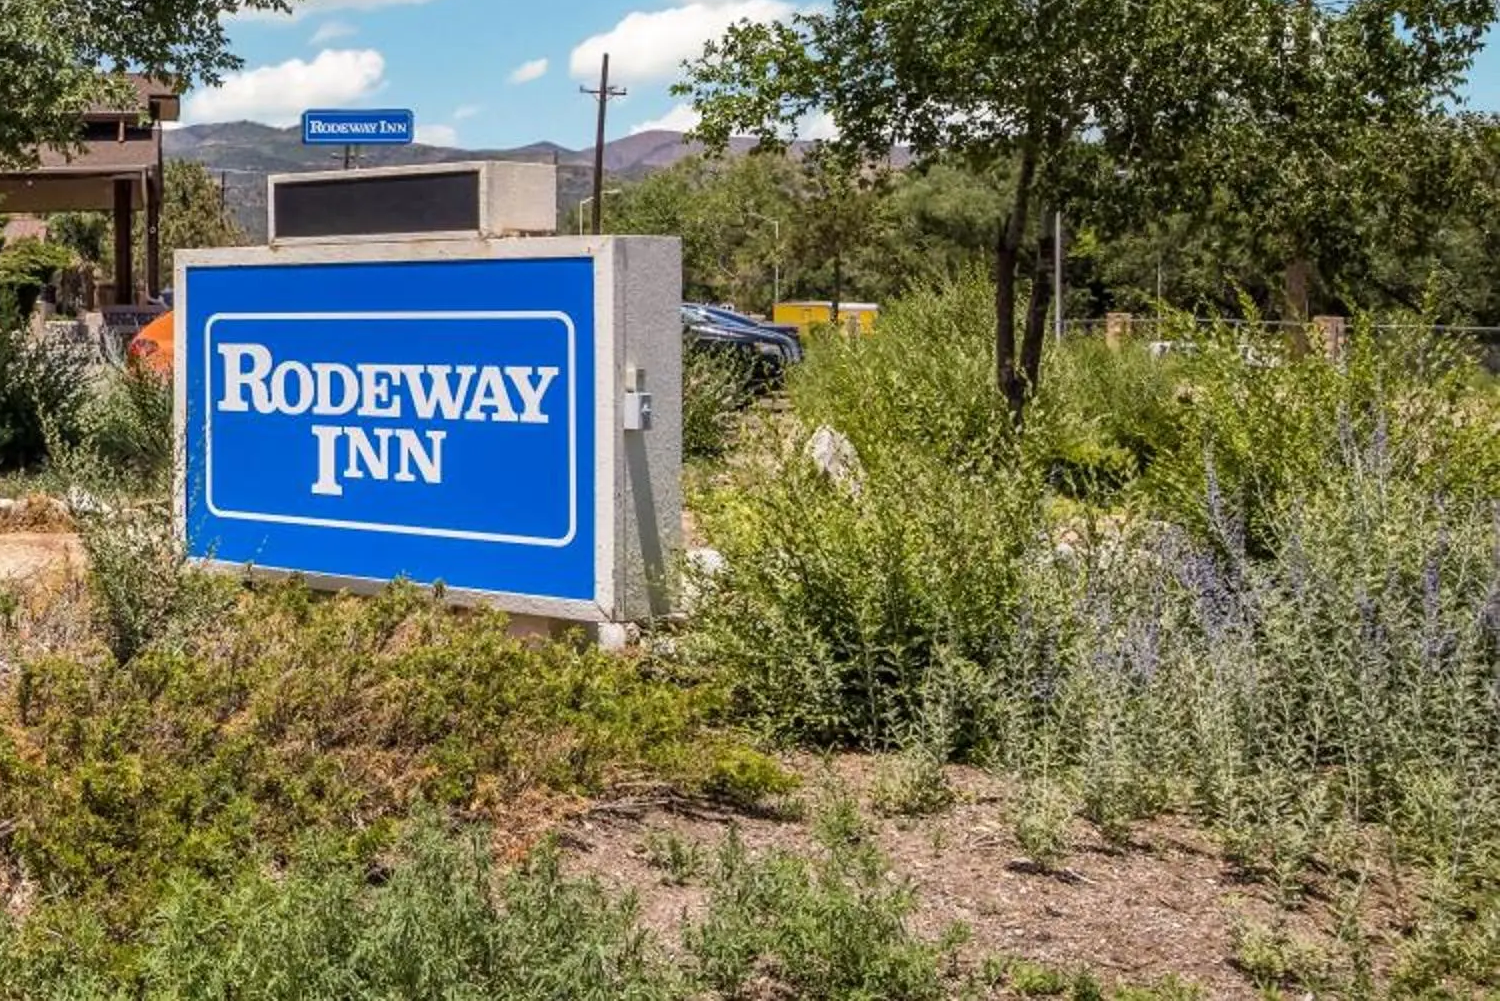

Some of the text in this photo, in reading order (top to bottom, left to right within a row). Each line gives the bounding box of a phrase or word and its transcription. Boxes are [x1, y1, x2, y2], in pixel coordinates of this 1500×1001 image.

[310, 120, 407, 134] RODEWAY INN
[217, 342, 559, 424] RODEWAY
[311, 425, 447, 496] INN
